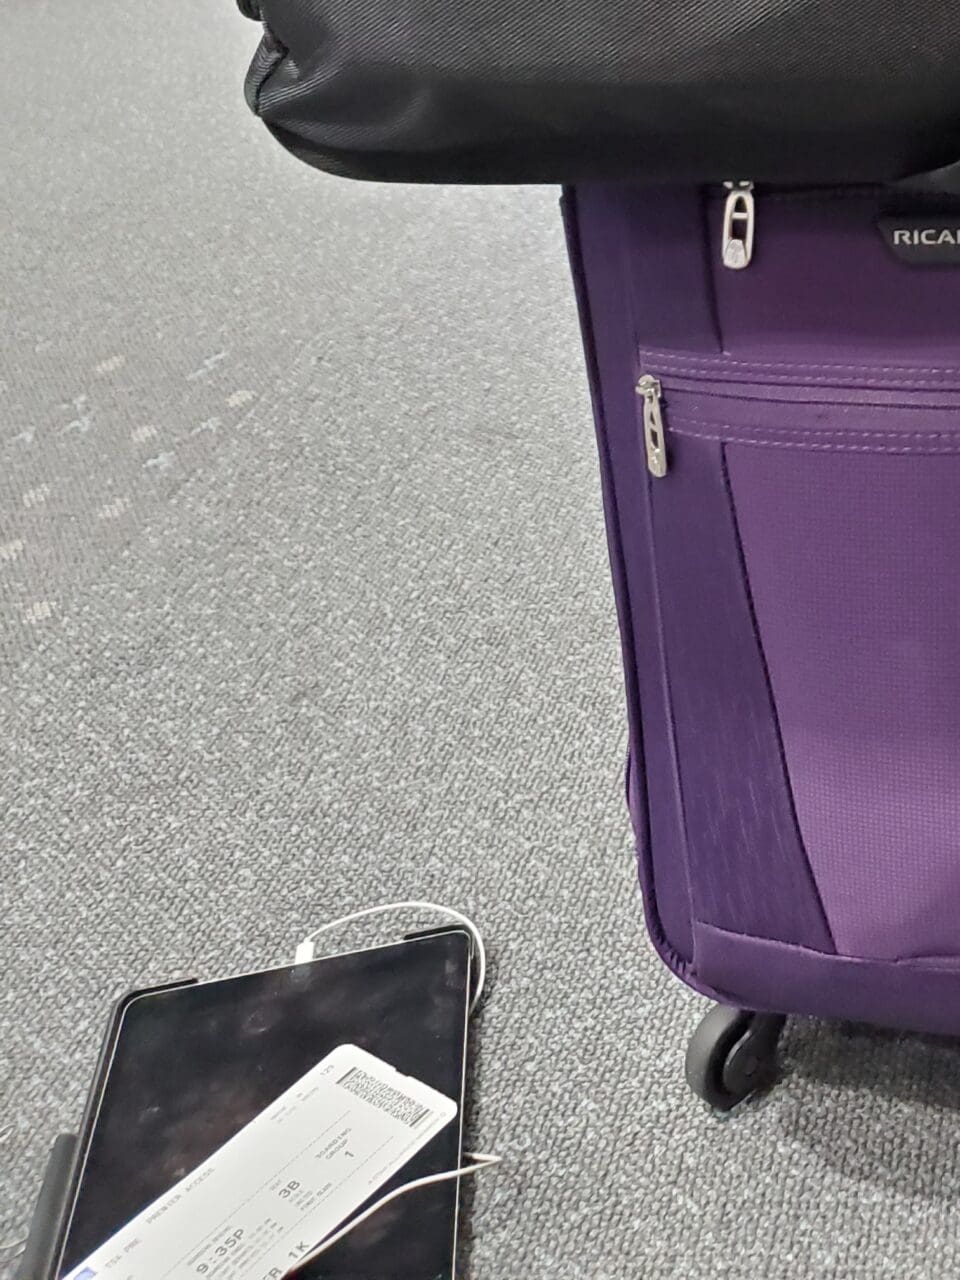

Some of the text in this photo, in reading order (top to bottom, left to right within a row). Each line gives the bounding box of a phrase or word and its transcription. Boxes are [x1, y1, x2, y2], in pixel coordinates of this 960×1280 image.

[325, 1138, 349, 1160] GROUP
[344, 1150, 355, 1158] 1
[278, 1180, 301, 1199] 3B
[195, 1227, 245, 1275] 9:35P
[287, 1240, 310, 1260] 1K
